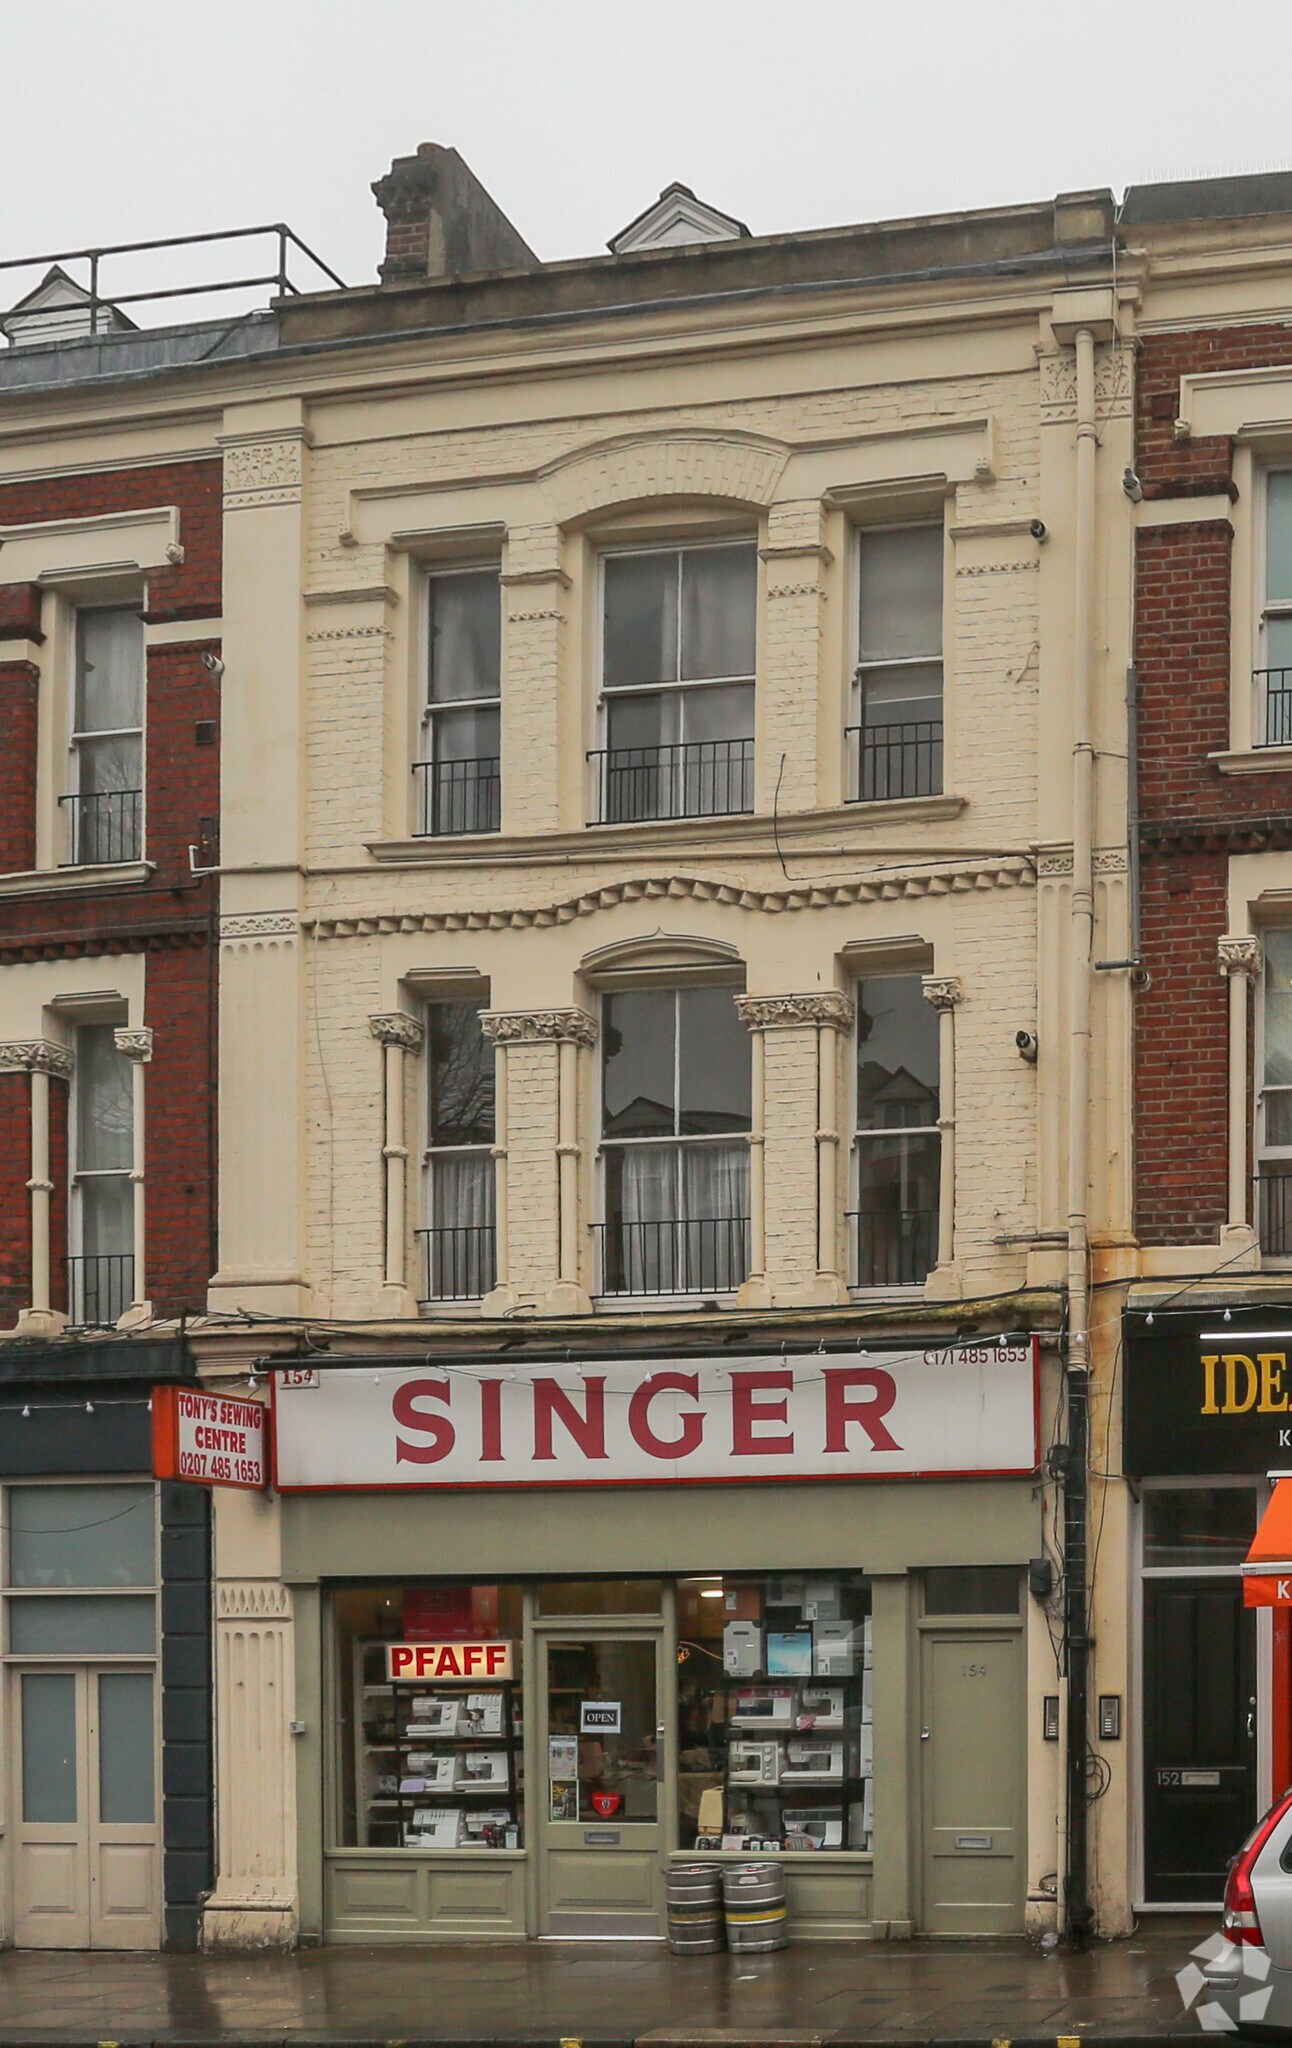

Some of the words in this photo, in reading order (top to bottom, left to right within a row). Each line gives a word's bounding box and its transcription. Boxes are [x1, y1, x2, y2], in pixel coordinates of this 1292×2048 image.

[958, 1347, 989, 1364] 485
[993, 1347, 1027, 1363] 1653
[282, 1367, 314, 1385] 154
[1200, 1352, 1292, 1414] IDE
[178, 1394, 218, 1423] TONY'S
[219, 1401, 261, 1430] SEWING
[392, 1368, 905, 1466] SINGER
[194, 1425, 247, 1454] CENTRE
[180, 1451, 208, 1476] 0207
[210, 1455, 232, 1479] 485
[234, 1459, 261, 1483] 1653
[391, 1645, 507, 1677] PFAFF
[962, 1664, 987, 1677] 154
[586, 1713, 615, 1723] OPEN
[1157, 1771, 1180, 1785] 152
